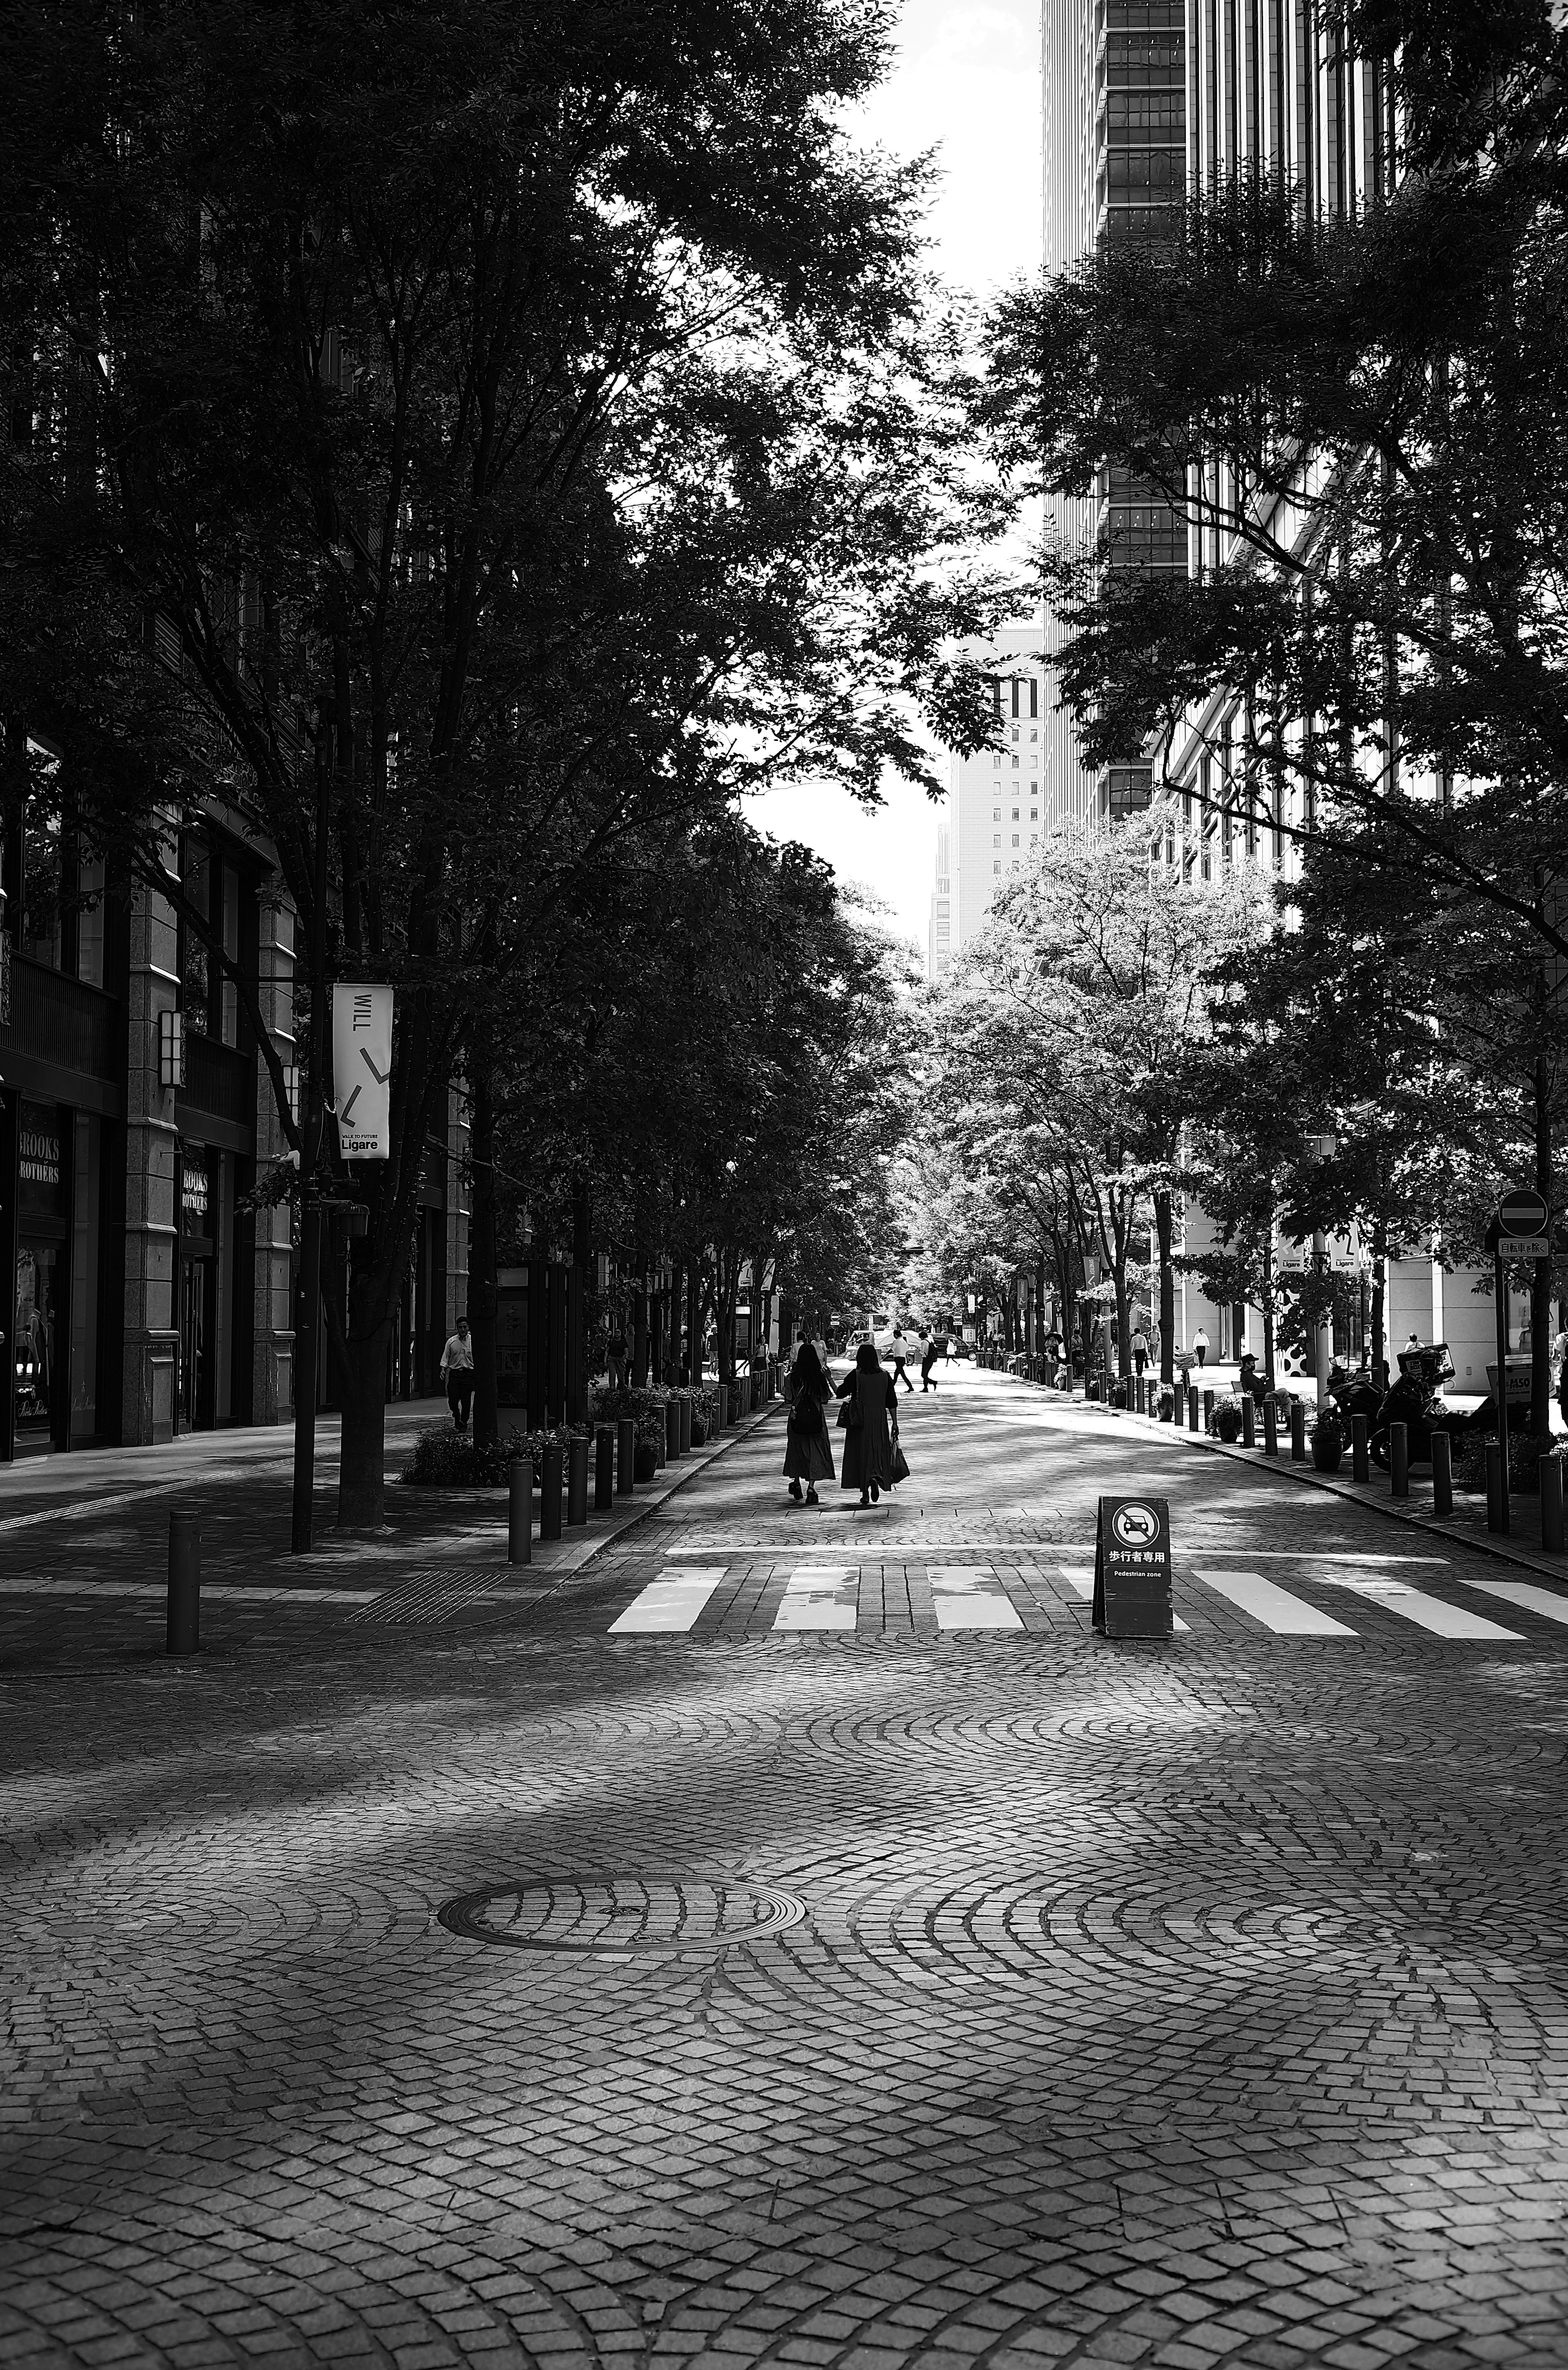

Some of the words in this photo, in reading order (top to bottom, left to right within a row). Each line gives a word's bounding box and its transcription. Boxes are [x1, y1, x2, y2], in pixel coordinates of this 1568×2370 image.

[353, 994, 372, 1031] WILL
[342, 1139, 378, 1152] Ligare
[19, 1160, 59, 1184] ROTHERS
[1501, 1243, 1545, 1253] 自転車を除く
[1108, 1550, 1165, 1563] 歩行者専用
